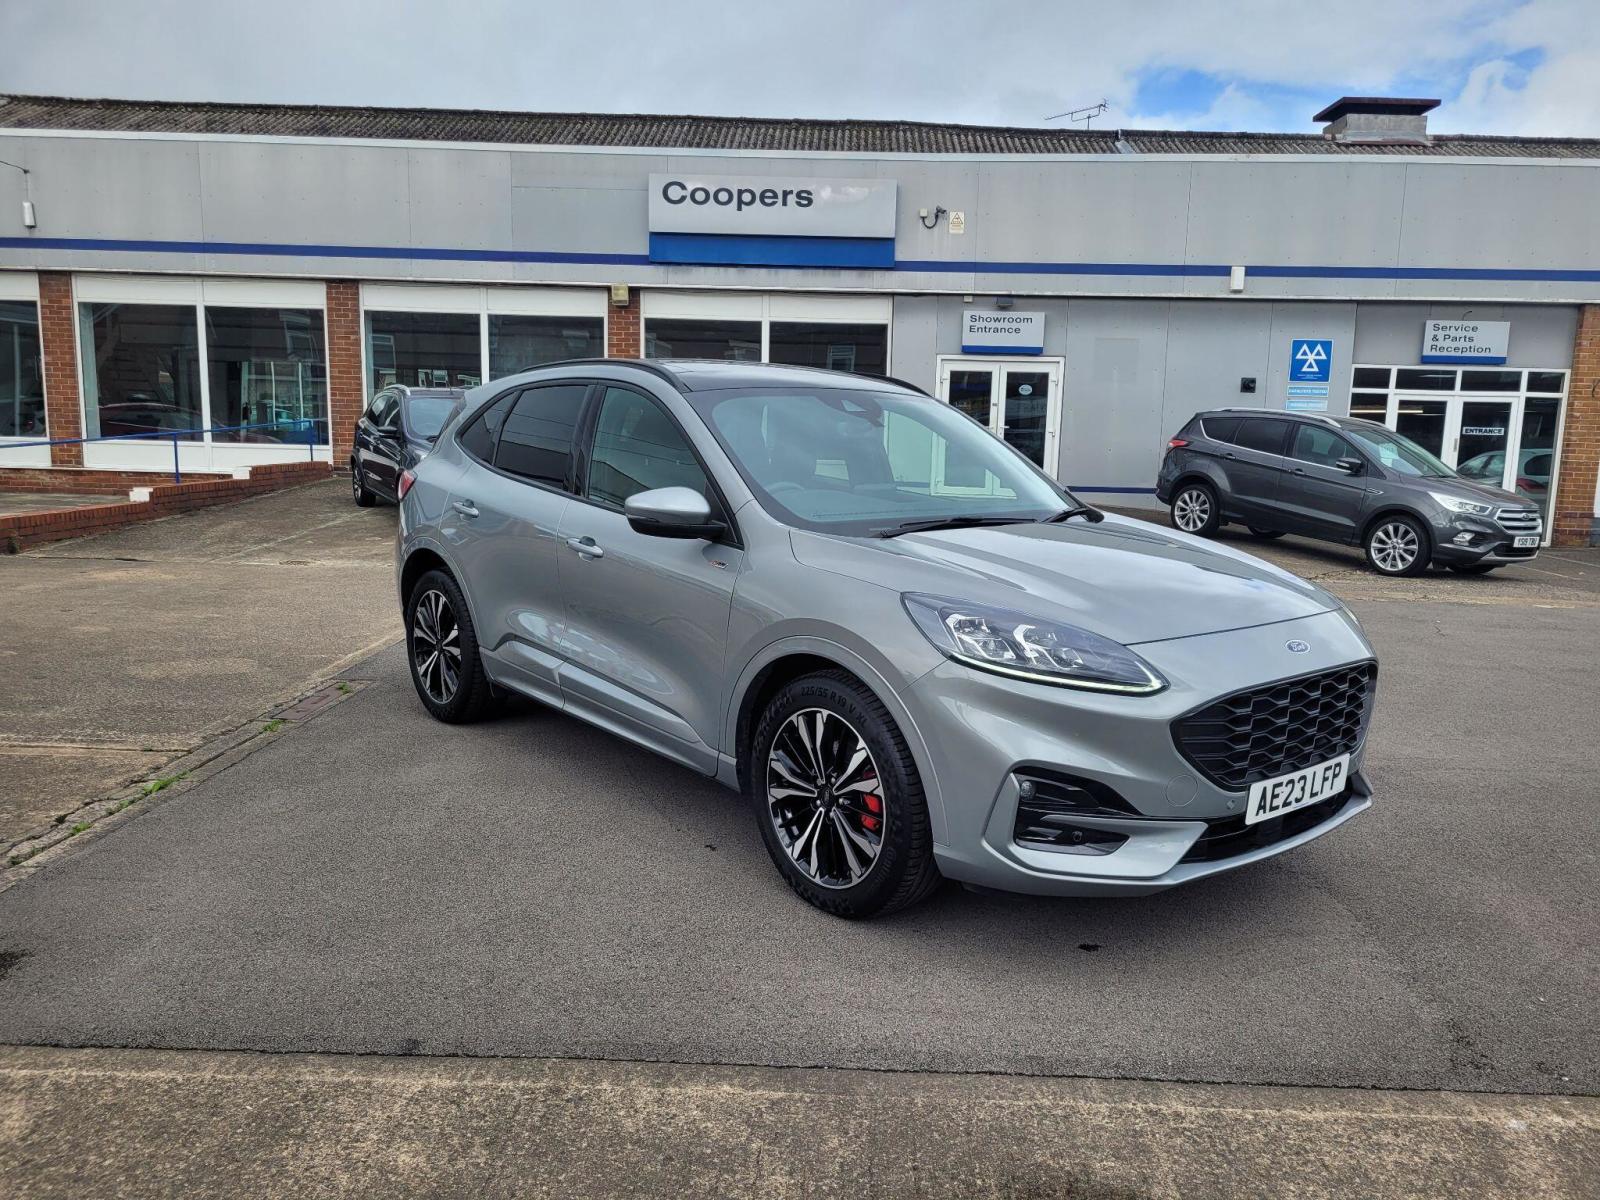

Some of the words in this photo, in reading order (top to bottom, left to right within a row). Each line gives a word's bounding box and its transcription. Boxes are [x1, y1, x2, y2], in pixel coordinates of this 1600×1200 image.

[662, 180, 814, 211] Coopers
[970, 314, 1032, 324] Showroom
[969, 325, 1021, 334] Entrance
[1432, 323, 1478, 332] Service
[1432, 334, 1439, 342] &
[1443, 334, 1474, 342] Parts
[1430, 344, 1491, 354] Reception
[1255, 775, 1307, 816] AE23
[1309, 762, 1342, 798] LFP
